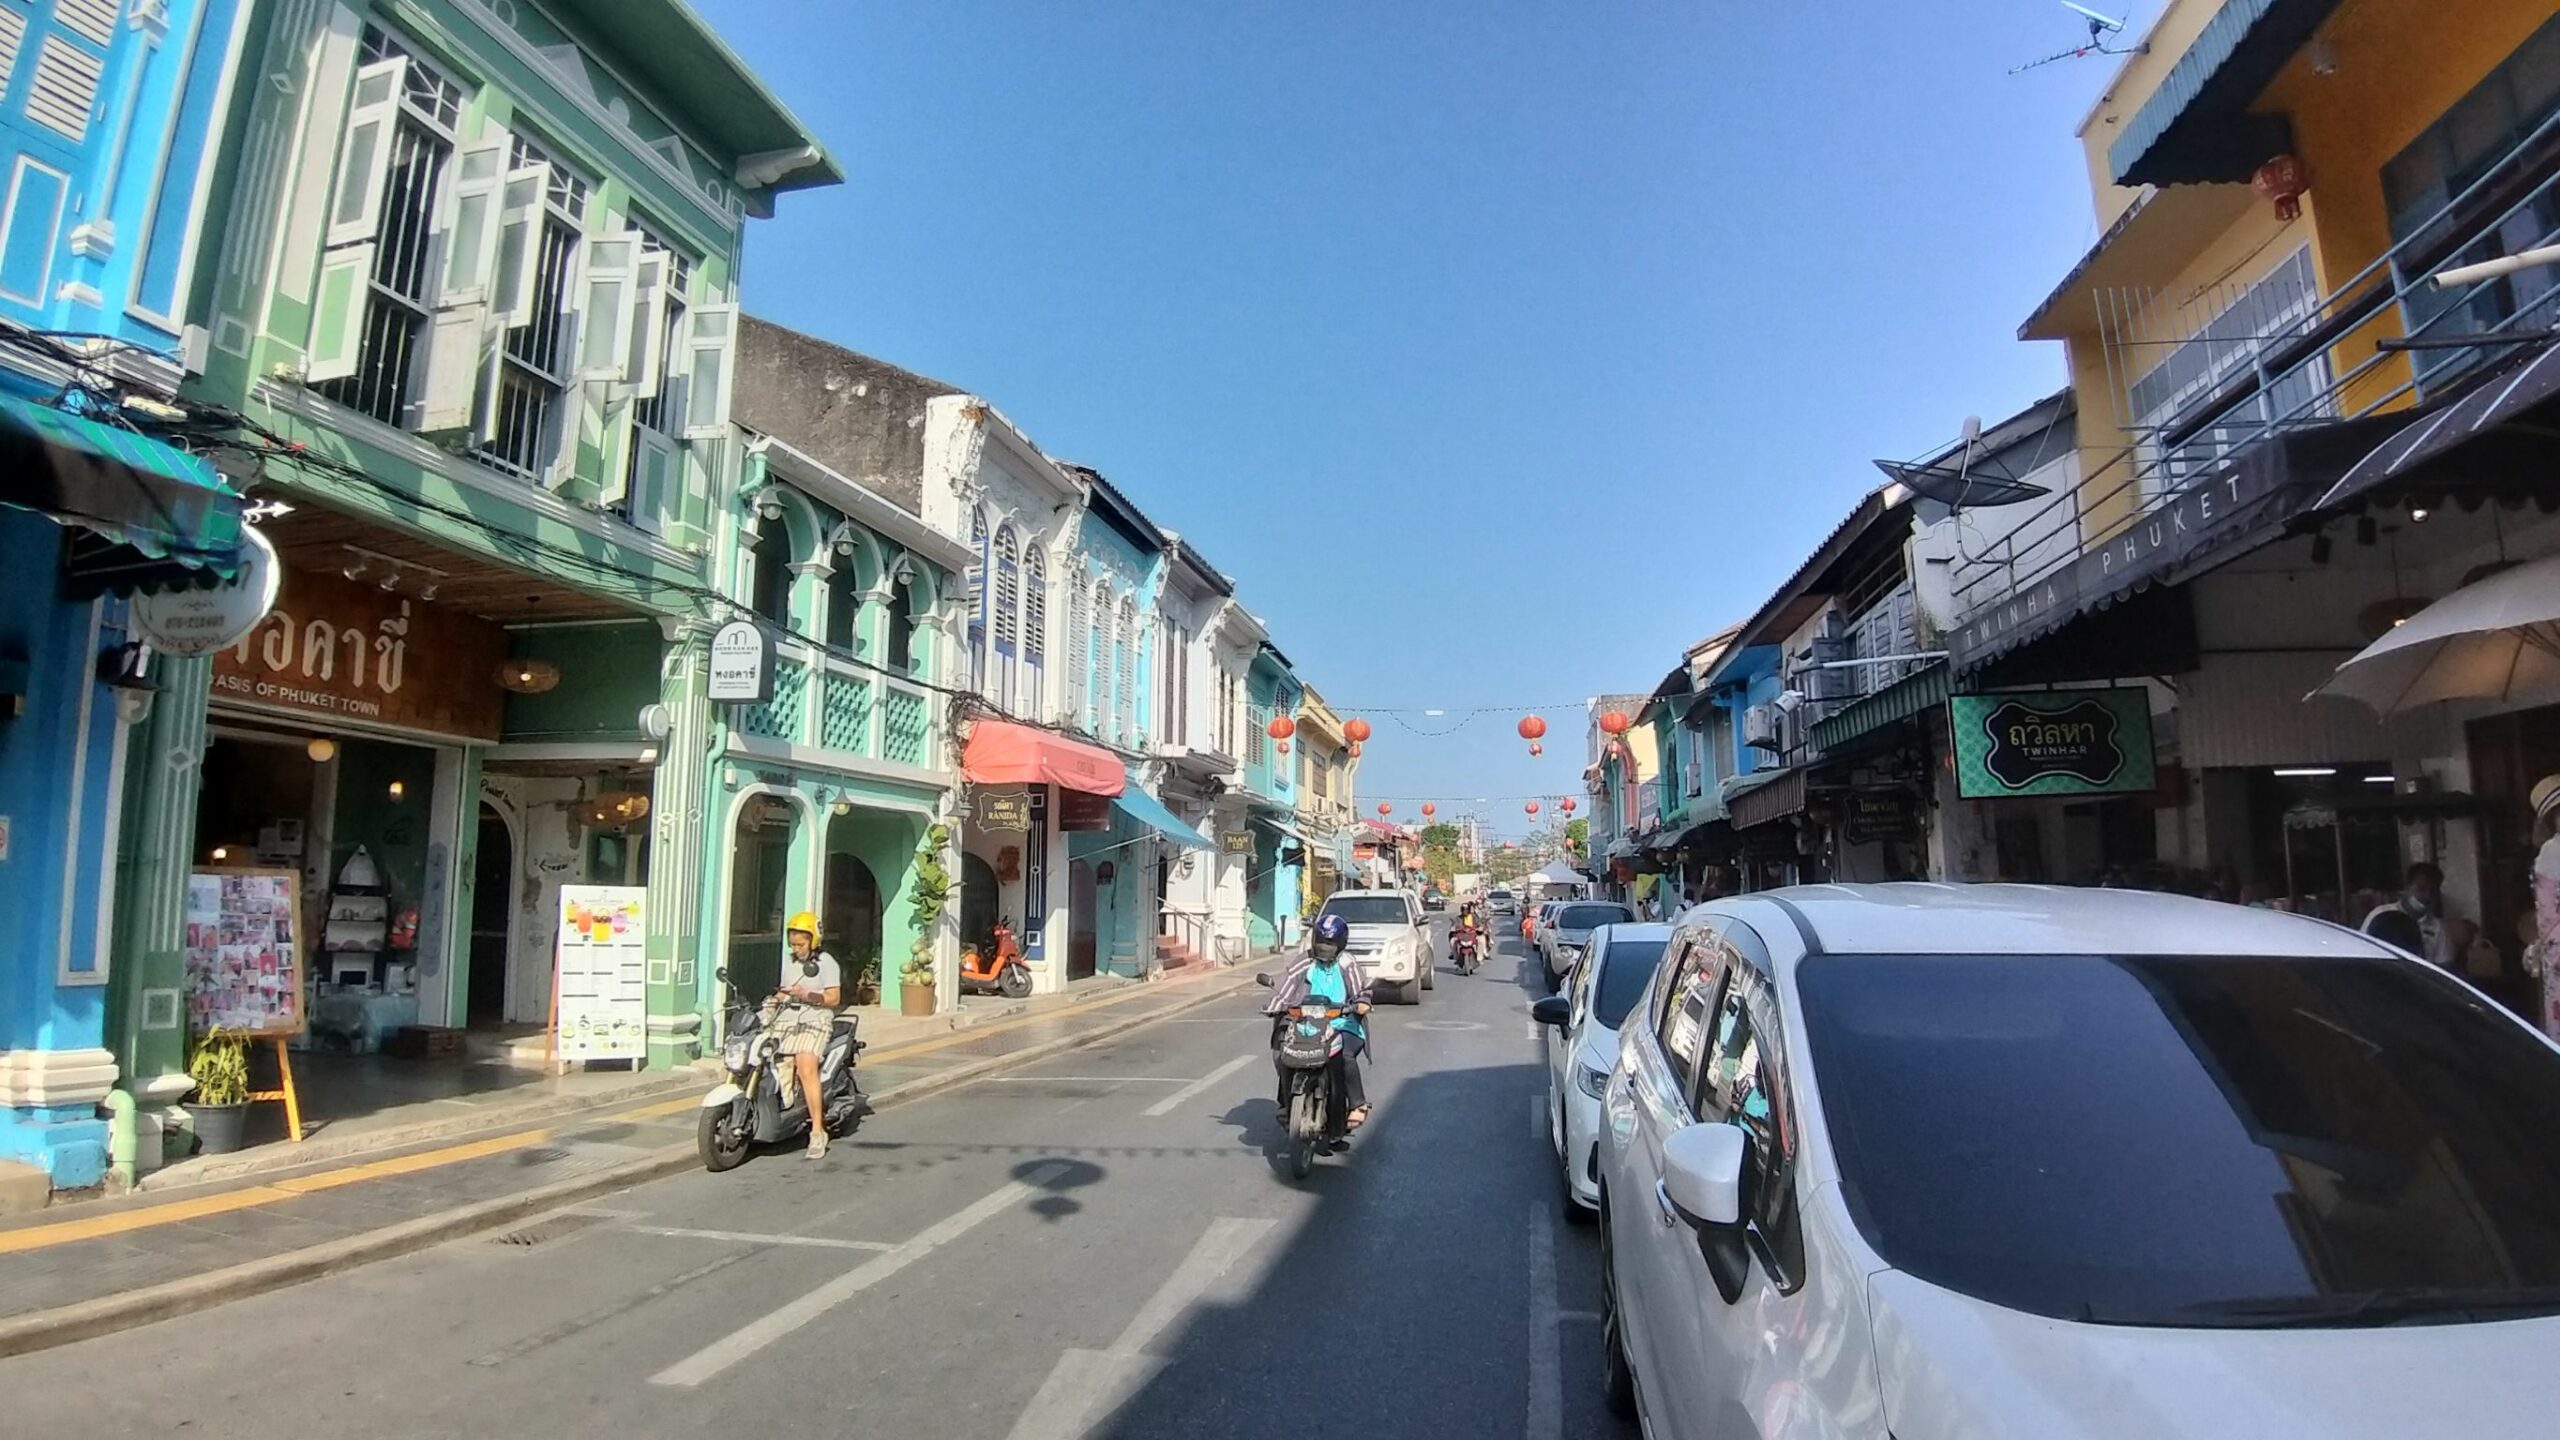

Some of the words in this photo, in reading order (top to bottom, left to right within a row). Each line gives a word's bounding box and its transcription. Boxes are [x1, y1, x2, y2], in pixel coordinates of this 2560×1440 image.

[1965, 585, 2056, 647] TWINHA
[2102, 474, 2240, 574] PHUKET
[256, 682, 276, 697] OF
[279, 687, 337, 708] PHUKET
[340, 698, 381, 717] TOWN
[2009, 715, 2095, 746] ถวิลหา
[2022, 746, 2087, 757] TWINHAR
[988, 811, 1018, 820] RANIDA
[1227, 836, 1248, 844] BAAN
